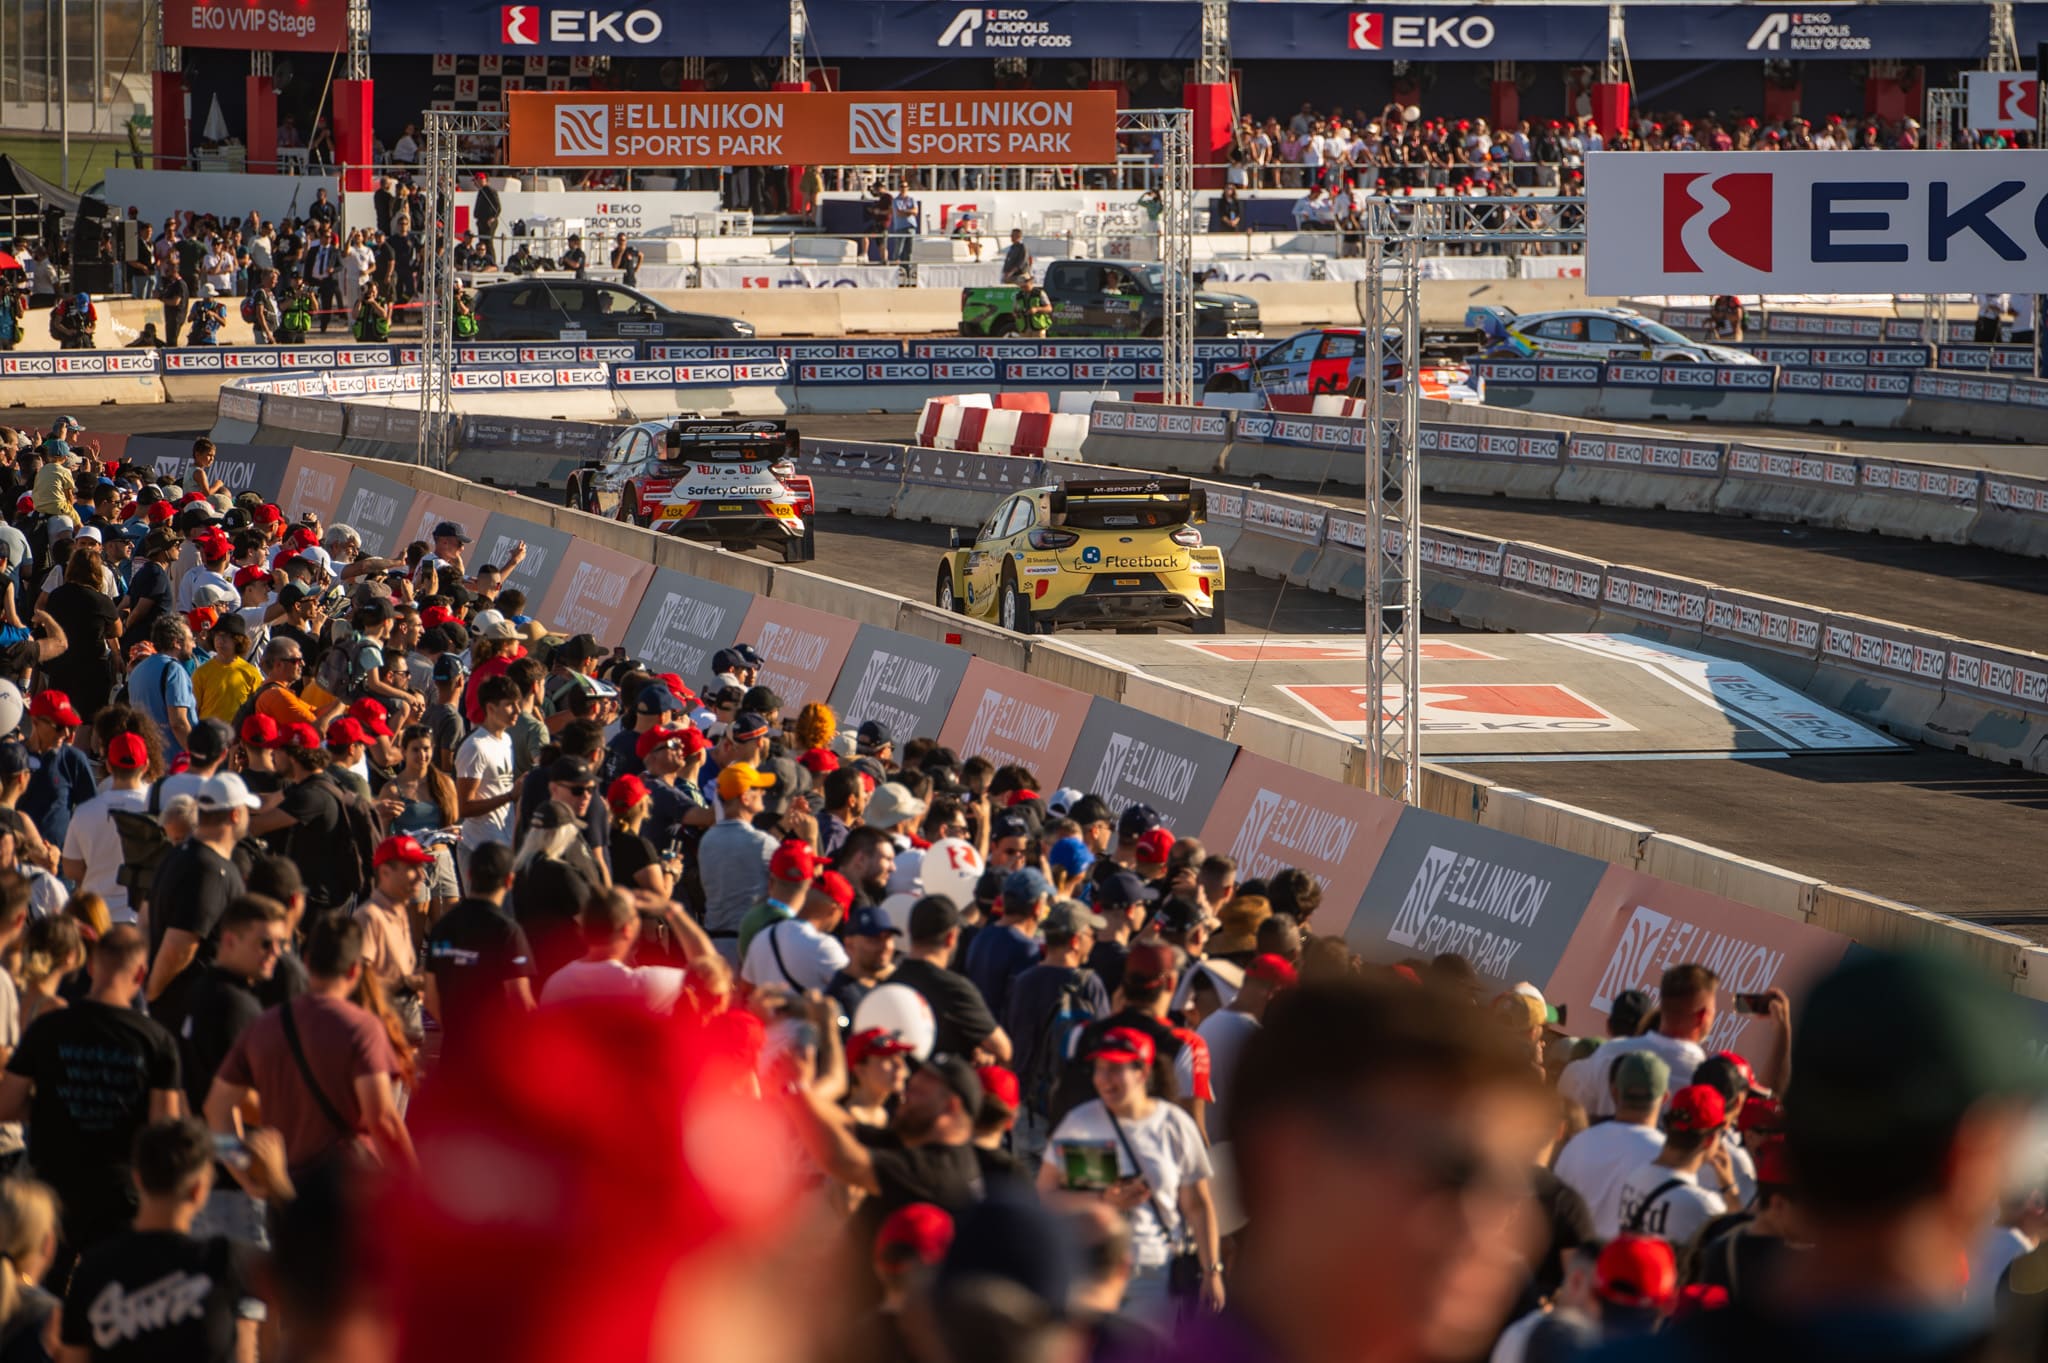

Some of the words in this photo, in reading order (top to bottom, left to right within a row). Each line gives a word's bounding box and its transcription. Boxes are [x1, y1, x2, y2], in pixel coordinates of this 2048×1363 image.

[192, 7, 224, 28] EKO
[225, 8, 264, 31] VVIP
[268, 13, 316, 37] Stage
[999, 10, 1028, 20] EKO
[1804, 14, 1831, 23] EKO
[551, 10, 662, 43] EKO
[986, 22, 1049, 34] ACROPOLIS
[1392, 16, 1495, 48] EKO
[1791, 25, 1850, 37] ACROPOLIS
[986, 35, 1020, 48] RALLY
[1022, 36, 1037, 46] OF
[1038, 36, 1072, 47] GODS
[1791, 38, 1824, 50] RALLY
[1825, 39, 1839, 50] OF
[1840, 38, 1871, 50] GODS
[615, 104, 624, 128] THE
[628, 104, 784, 128] ELLINIKON
[908, 103, 916, 126] THE
[920, 102, 1072, 126] ELLINIKON
[615, 135, 710, 156] SPORTS
[718, 135, 782, 156] PARK
[908, 134, 1000, 153] SPORTS
[1008, 133, 1072, 152] PARK
[610, 204, 642, 214] EKO
[1811, 181, 2048, 262] EK
[19, 360, 52, 372] EKO
[71, 359, 102, 370] EKO
[121, 358, 152, 370] EKO
[183, 355, 220, 368] EKO
[241, 354, 278, 366] EKO
[298, 353, 334, 365] EKO
[354, 352, 389, 363] EKO
[478, 350, 515, 362] EKO
[538, 349, 574, 360] EKO
[597, 348, 634, 360] EKO
[796, 346, 836, 358] EKO
[858, 346, 898, 358] EKO
[934, 346, 975, 358] EKO
[997, 346, 1038, 358] EKO
[1060, 346, 1100, 358] EKO
[1771, 351, 1808, 362] EKO
[1829, 351, 1867, 363] EKO
[1887, 351, 1926, 364] EKO
[1956, 352, 1988, 364] EKO
[467, 373, 500, 384] EKO
[520, 372, 552, 384] EKO
[571, 372, 604, 382] EKO
[634, 369, 671, 381] EKO
[693, 368, 729, 380] EKO
[752, 366, 786, 378] EKO
[823, 366, 863, 379] EKO
[887, 365, 926, 378] EKO
[952, 364, 994, 377] EKO
[1027, 364, 1069, 378] EKO
[1092, 364, 1135, 378] EKO
[1497, 367, 1536, 380] EKO
[1557, 368, 1596, 380] EKO
[1624, 368, 1659, 380] EKO
[1678, 370, 1714, 382] EKO
[1734, 372, 1770, 384] EKO
[340, 379, 364, 391] EKO
[1792, 373, 1820, 384] EKO
[1834, 375, 1864, 388] EKO
[1879, 376, 1909, 390] EKO
[1102, 414, 1124, 427] EKO
[1135, 416, 1157, 428] EKO
[1169, 417, 1191, 430] EKO
[1202, 418, 1225, 432] EKO
[1247, 420, 1271, 434] EKO
[1286, 426, 1310, 440] EKO
[1324, 426, 1350, 442] EKO
[1450, 435, 1476, 450] EKO
[1490, 438, 1516, 453] EKO
[1531, 441, 1557, 456] EKO
[1580, 443, 1604, 458] EKO
[1617, 446, 1641, 462] EKO
[1655, 449, 1679, 464] EKO
[1692, 450, 1718, 466] EKO
[1738, 454, 1759, 470] EKO
[1770, 457, 1790, 474] EKO
[1802, 462, 1822, 478] EKO
[1833, 466, 1854, 482] EKO
[1871, 468, 1890, 484] EKO
[1900, 471, 1918, 488] EKO
[1929, 474, 1948, 492] EKO
[1958, 480, 1976, 496] EKO
[1992, 485, 2008, 502] EKO
[2018, 488, 2034, 506] EKO
[1106, 556, 1178, 568] Fleetback
[1511, 558, 1526, 578] EKO
[1535, 564, 1550, 584] EKO
[1558, 570, 1574, 590] EKO
[1582, 575, 1598, 596] EKO
[1612, 582, 1629, 602] EKO
[1638, 586, 1653, 608] EKO
[1662, 592, 1678, 614] EKO
[1687, 598, 1704, 618] EKO
[672, 597, 726, 640] ELLINIKON
[1714, 604, 1733, 626] EKO
[1741, 611, 1760, 632] EKO
[1769, 617, 1788, 638] EKO
[1798, 624, 1817, 644] EKO
[772, 626, 830, 672] ELLINIKON
[1832, 632, 1852, 654] EKO
[1862, 638, 1882, 660] EKO
[1893, 644, 1912, 666] EKO
[1923, 652, 1944, 674] EKO
[881, 655, 940, 704] ELLINIKON
[1957, 659, 1979, 681] EKO
[1990, 667, 2012, 688] EKO
[2024, 674, 2046, 698] EKO
[1722, 683, 1778, 701] EKO
[995, 696, 1060, 752] ELLINIKON
[1419, 722, 1611, 730] EKO
[1793, 720, 1852, 740] EKO
[1126, 741, 1198, 804] ELLINIKON
[1272, 799, 1358, 865] ELLINIKON
[1448, 856, 1552, 928] ELLINIKON
[1418, 914, 1481, 965] SPORTS
[1474, 928, 1522, 980] PARK
